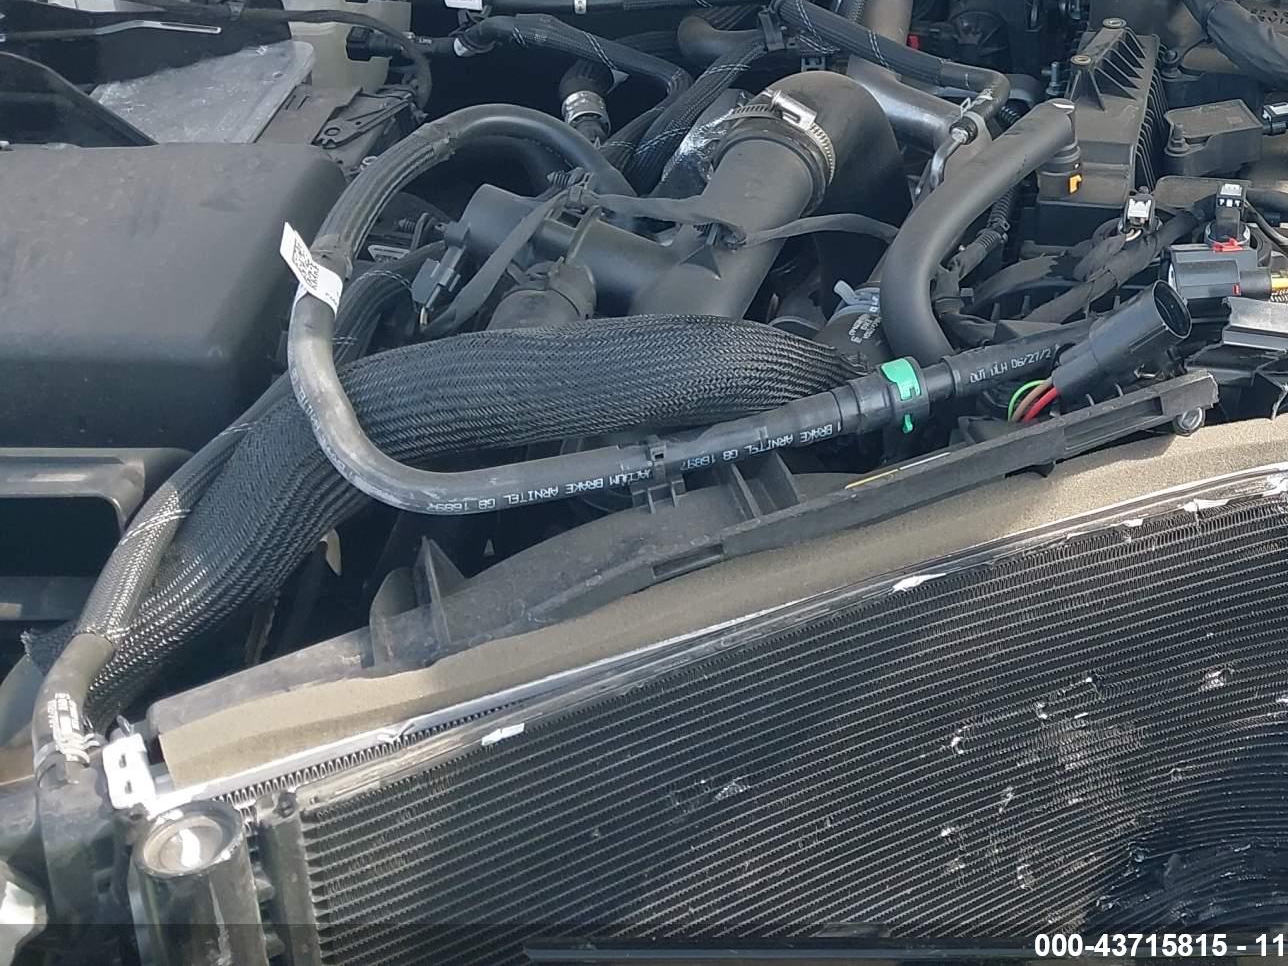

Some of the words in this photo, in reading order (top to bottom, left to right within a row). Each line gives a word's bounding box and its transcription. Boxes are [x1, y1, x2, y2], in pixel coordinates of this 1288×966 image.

[799, 423, 833, 443] BRAKE
[722, 449, 739, 462] GB
[502, 485, 560, 505] ARNITEL
[565, 477, 604, 495] BRAKE
[477, 497, 496, 510] GB
